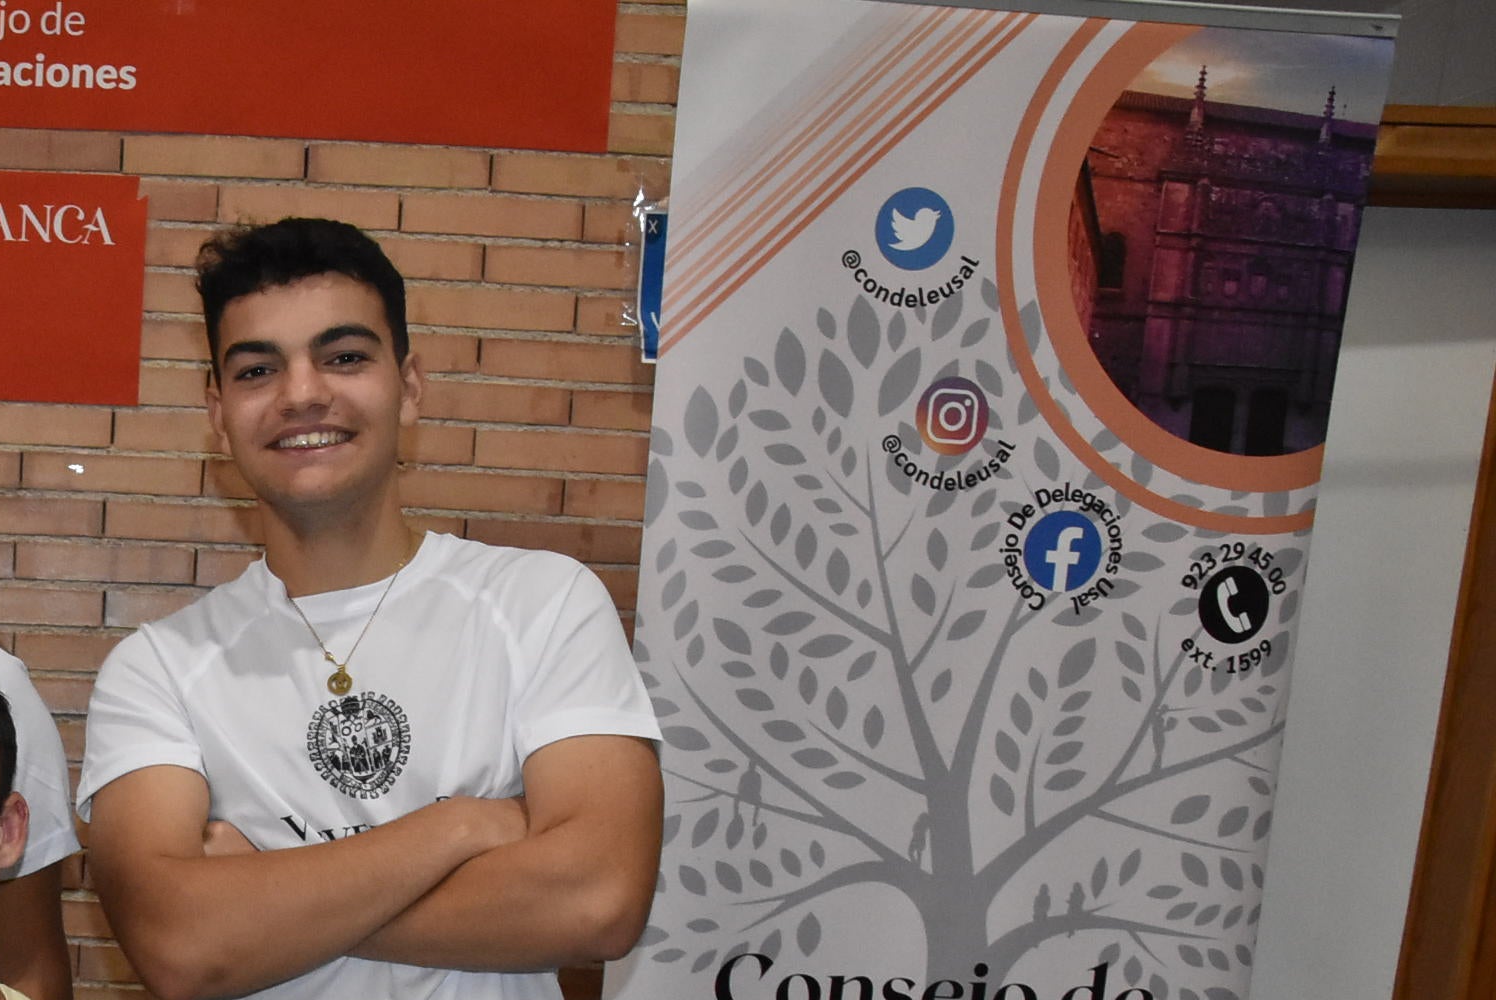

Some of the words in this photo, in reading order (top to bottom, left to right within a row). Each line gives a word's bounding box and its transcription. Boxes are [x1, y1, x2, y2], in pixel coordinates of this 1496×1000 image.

[41, 2, 86, 37] de
[841, 249, 980, 309] @condeleusal
[881, 434, 1017, 492] @condeleusal
[1007, 503, 1036, 531] De
[1034, 482, 1123, 575] Delegaciones
[999, 533, 1045, 611] Consejo
[1181, 552, 1217, 590] 923
[1219, 542, 1245, 563] 29
[1248, 547, 1274, 570] 45
[1268, 567, 1286, 595] 00
[1070, 577, 1115, 616] Usal
[1181, 638, 1217, 672] ext.
[1226, 639, 1272, 674] 1599
